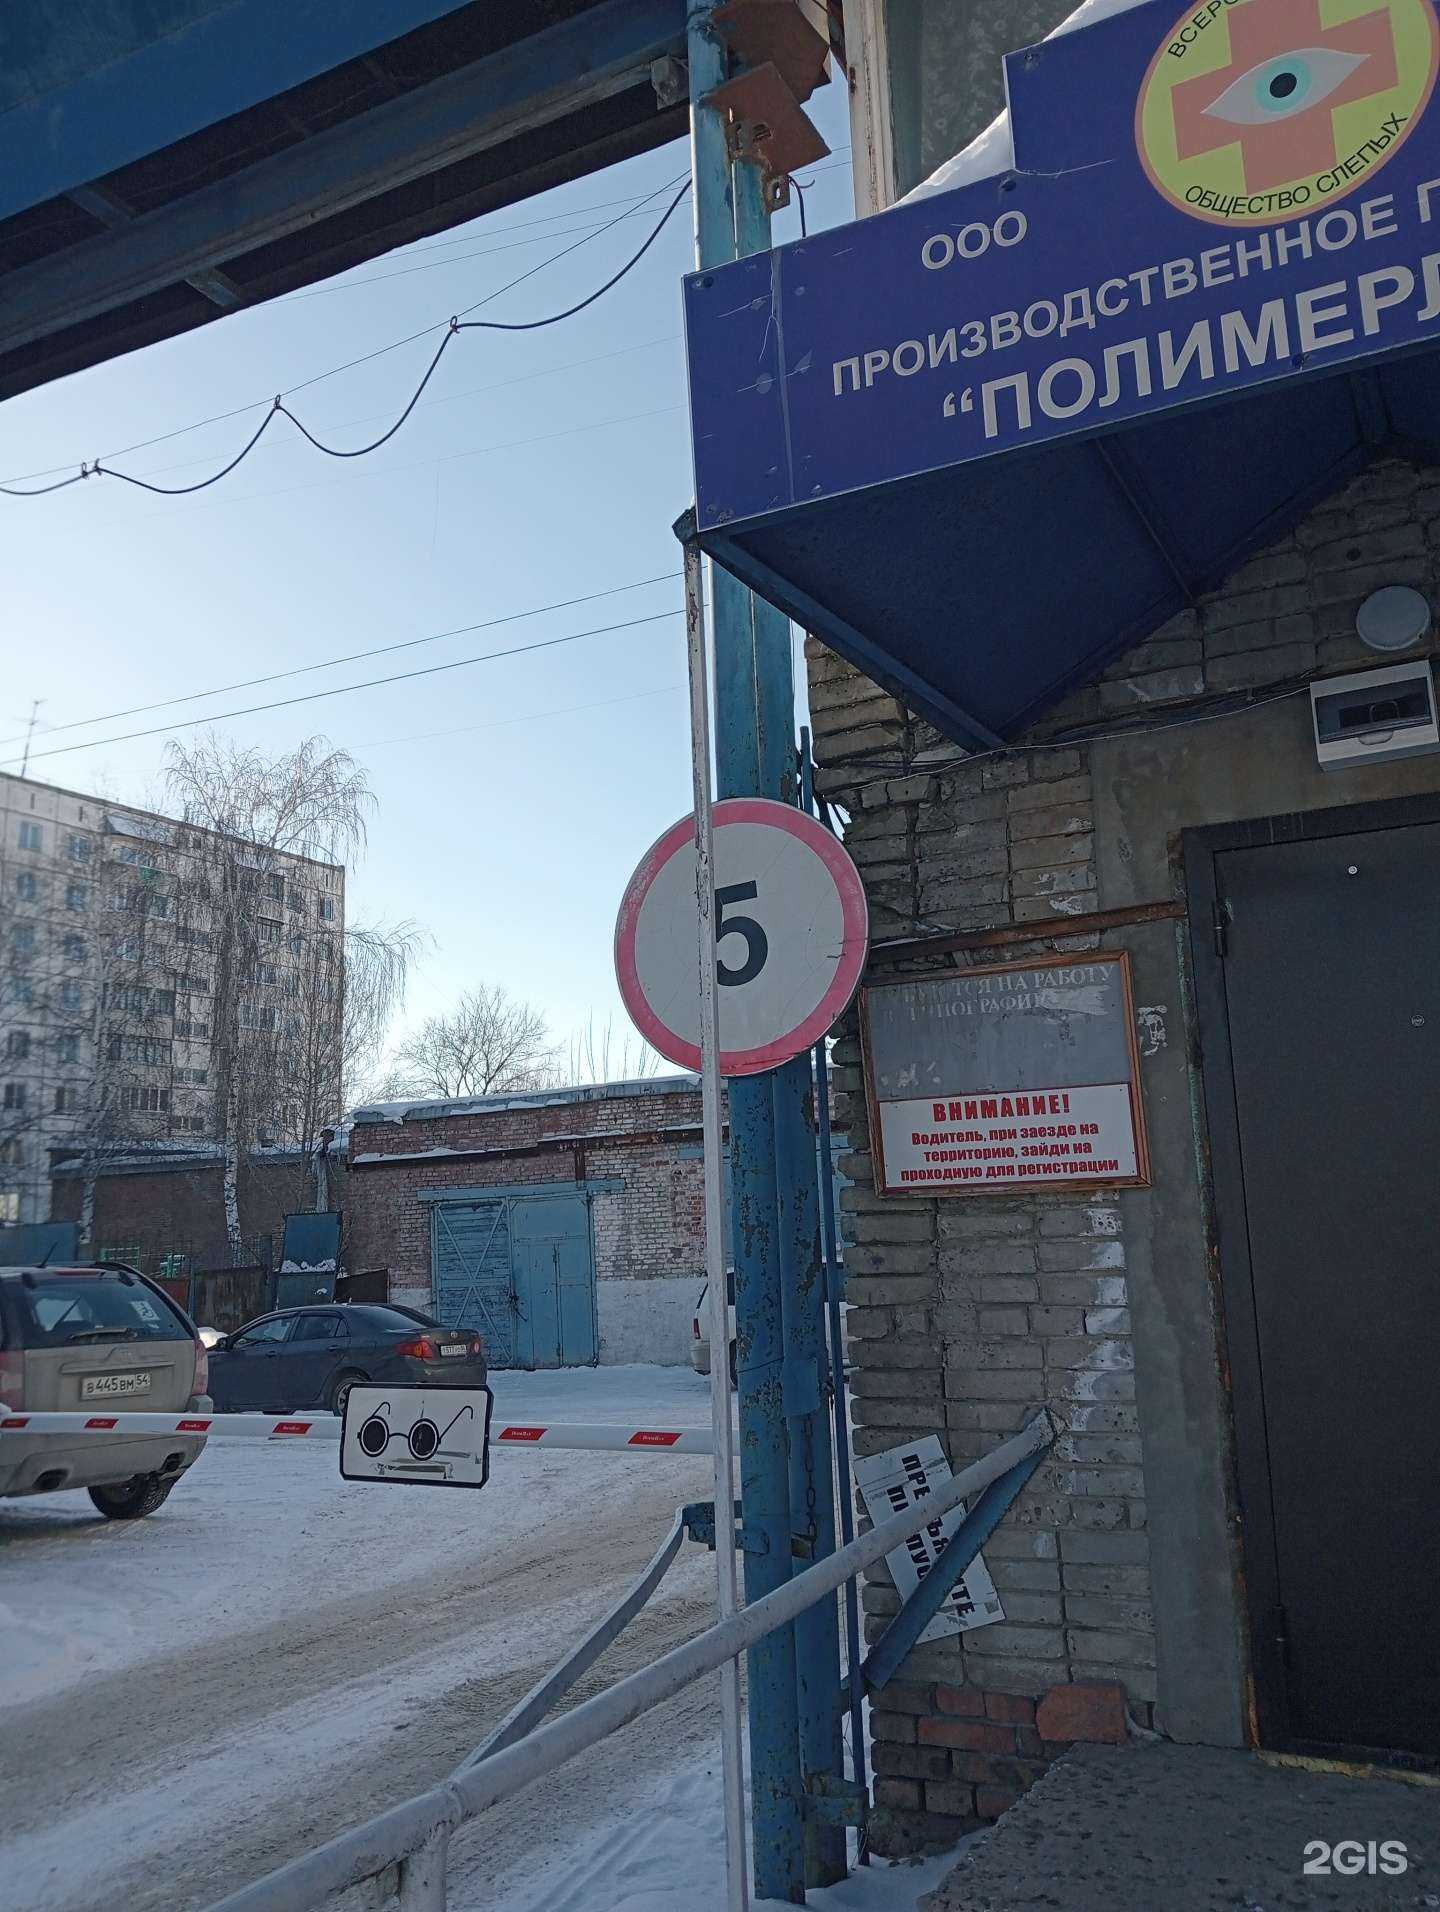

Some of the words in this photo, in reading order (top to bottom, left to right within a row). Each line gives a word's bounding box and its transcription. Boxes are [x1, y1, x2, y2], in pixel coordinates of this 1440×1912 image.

[1184, 185, 1311, 218] ОБЩЕСТВО
[1315, 112, 1408, 194] СЛЕПЫХ
[920, 209, 1029, 271] ООО
[831, 194, 1399, 397] ПРОИЗВОДСТВЕННОЕ
[714, 879, 769, 987] 5
[998, 976, 1028, 992] НА
[1033, 965, 1115, 988] РАБОТУ
[932, 1093, 1071, 1123] ВНИМАНИЕ!
[911, 1130, 988, 1147] Водитель,
[989, 1128, 1018, 1142] при
[1020, 1123, 1077, 1139] заезде
[1079, 1122, 1099, 1136] на
[923, 1146, 1019, 1163] территорию,
[1020, 1142, 1071, 1158] зайди
[1072, 1141, 1093, 1155] на
[900, 1164, 983, 1182] проходную
[985, 1163, 1015, 1179] для
[1018, 1159, 1120, 1177] регистрации
